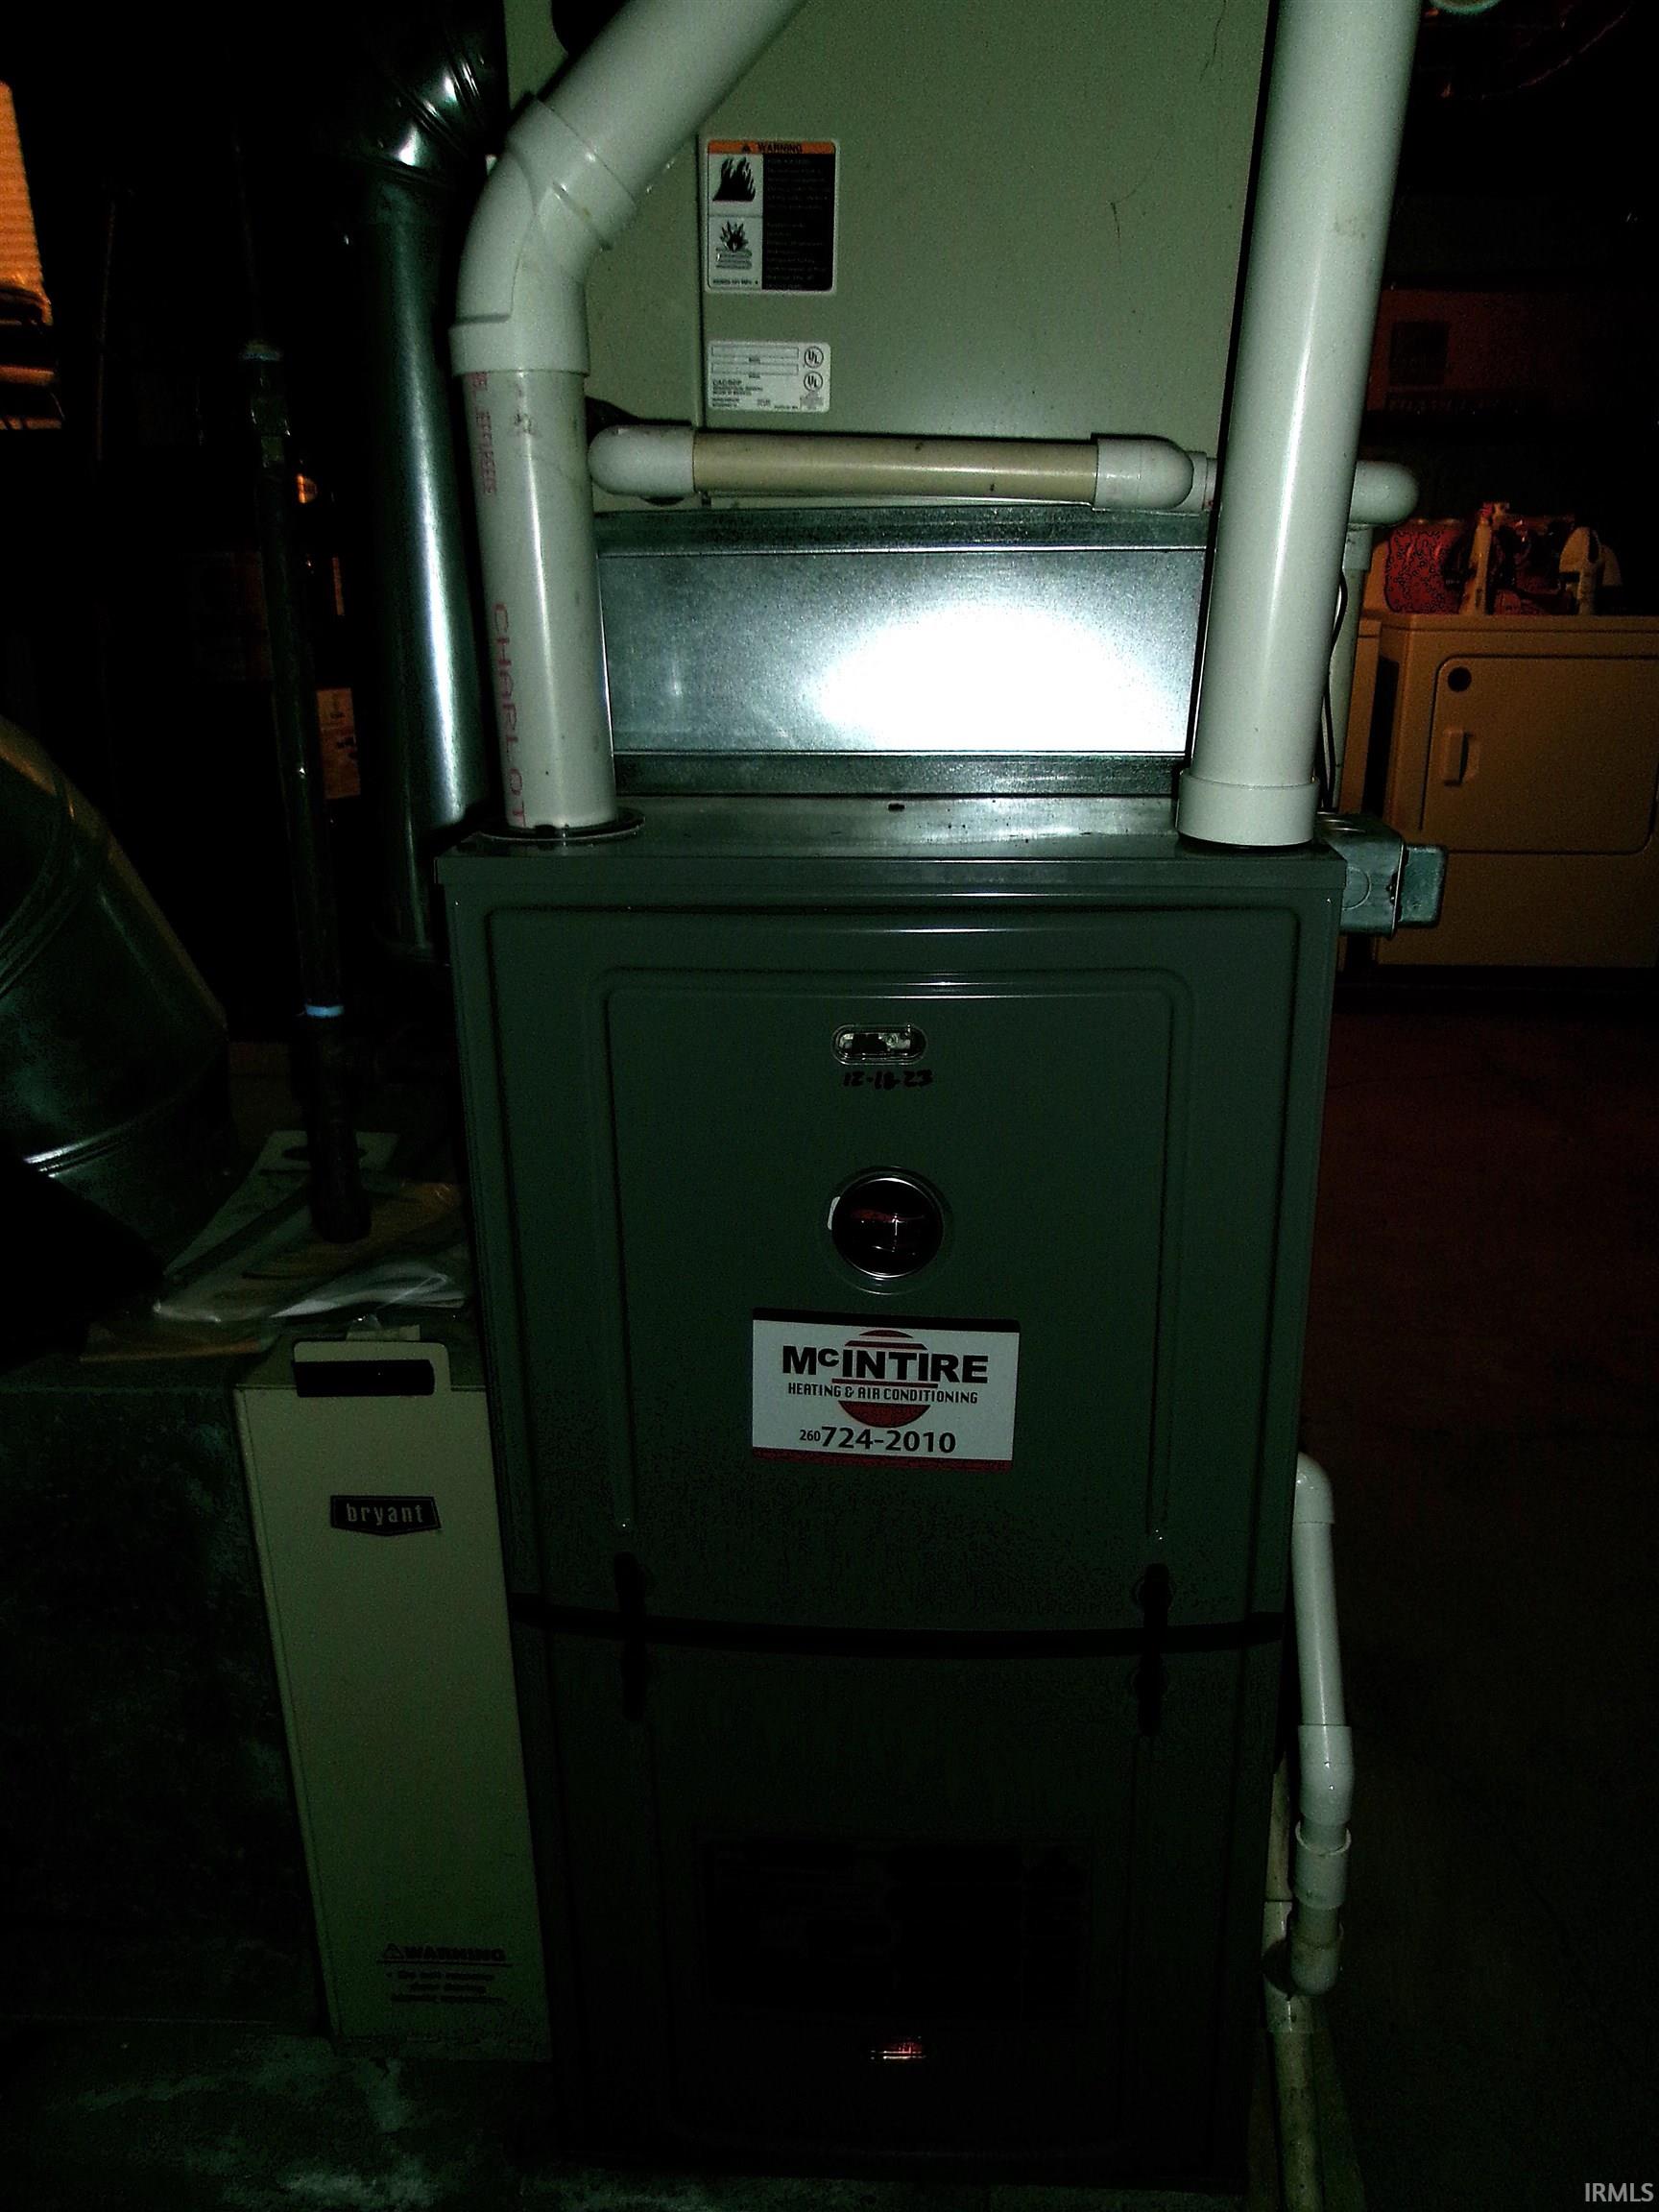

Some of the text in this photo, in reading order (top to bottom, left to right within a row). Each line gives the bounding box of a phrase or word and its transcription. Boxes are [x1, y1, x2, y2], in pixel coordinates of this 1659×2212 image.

[788, 1382, 978, 1405] HEATING & AIR CONDITIONING
[800, 1427, 956, 1453] 260 724-2010
[346, 1502, 423, 1527] bryant
